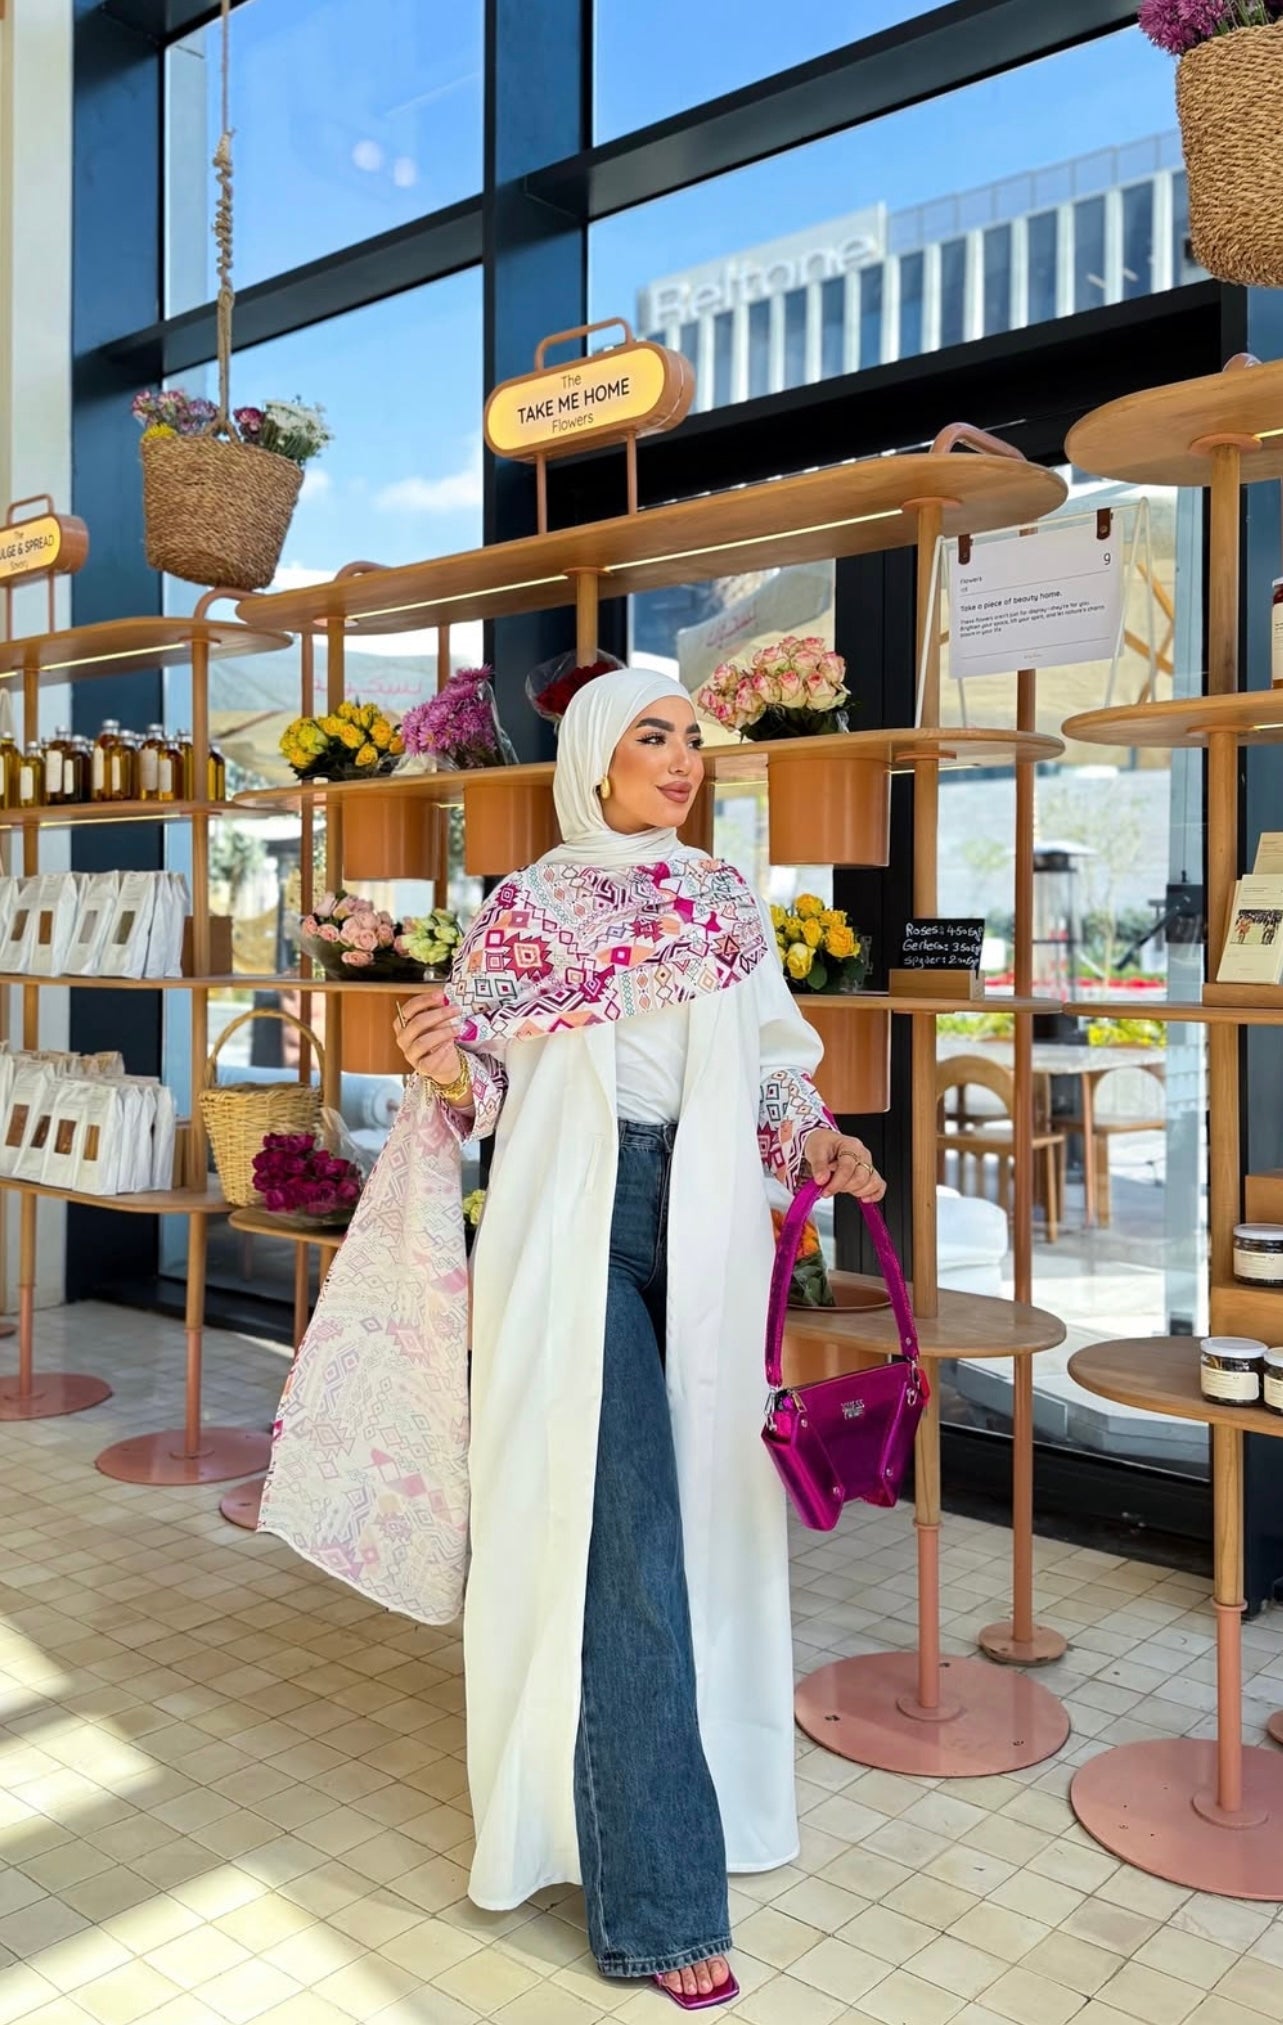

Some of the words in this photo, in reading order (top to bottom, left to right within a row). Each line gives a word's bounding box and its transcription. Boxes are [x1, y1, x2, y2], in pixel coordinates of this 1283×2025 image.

[561, 373, 582, 390] The
[517, 399, 554, 424] TAKE
[558, 391, 579, 414] ME
[584, 377, 630, 406] HOME
[552, 412, 594, 434] Flowers
[0, 543, 16, 560] LGE
[25, 533, 55, 554] SPREAD
[1103, 552, 1111, 566] 9
[960, 604, 976, 612] Take
[983, 600, 1002, 610] piece
[1003, 597, 1012, 606] of
[1012, 594, 1039, 604] beauty
[1039, 590, 1063, 600] home.
